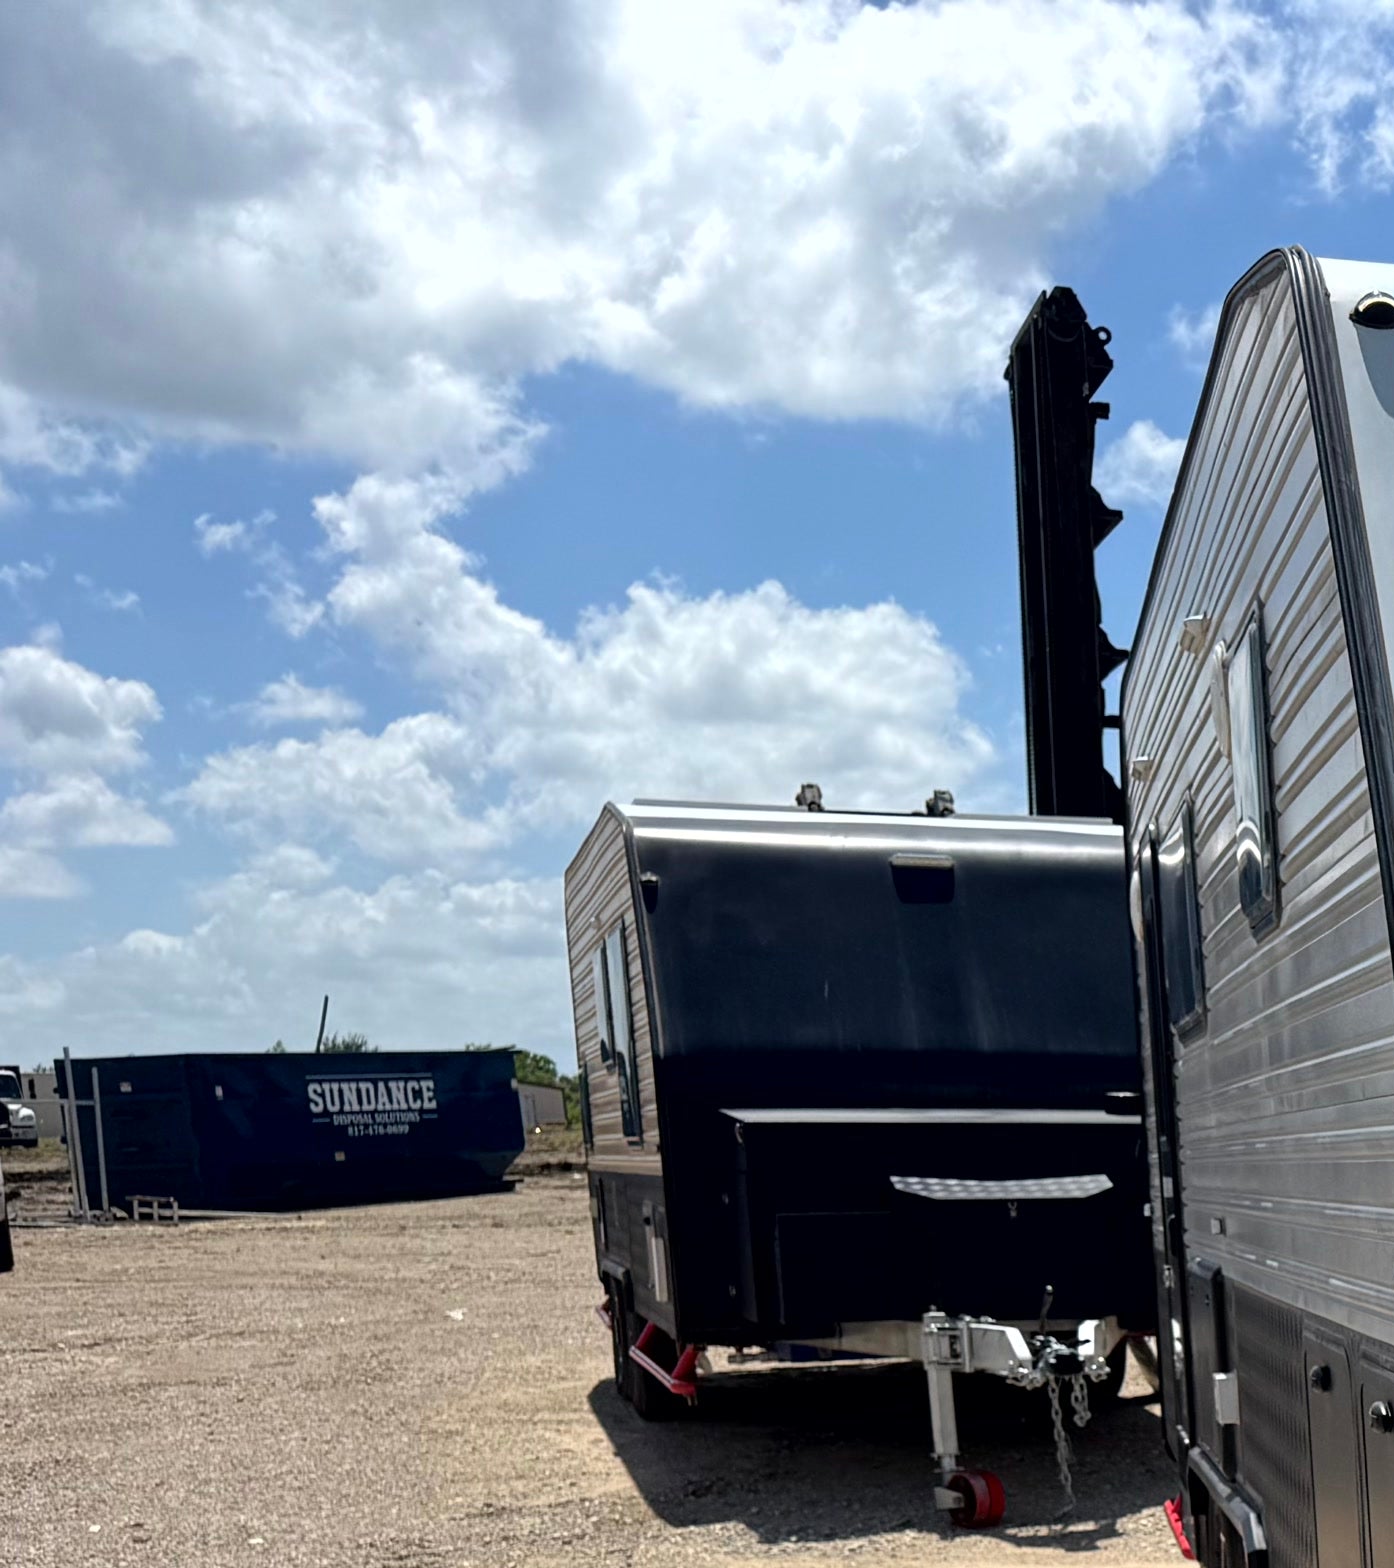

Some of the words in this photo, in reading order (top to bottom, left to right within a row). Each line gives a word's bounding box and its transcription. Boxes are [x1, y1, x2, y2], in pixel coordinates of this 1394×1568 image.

[307, 1080, 437, 1113] SUNDANCE
[333, 1113, 373, 1126] DISPOSAL
[374, 1111, 420, 1124] SOLUTIONS
